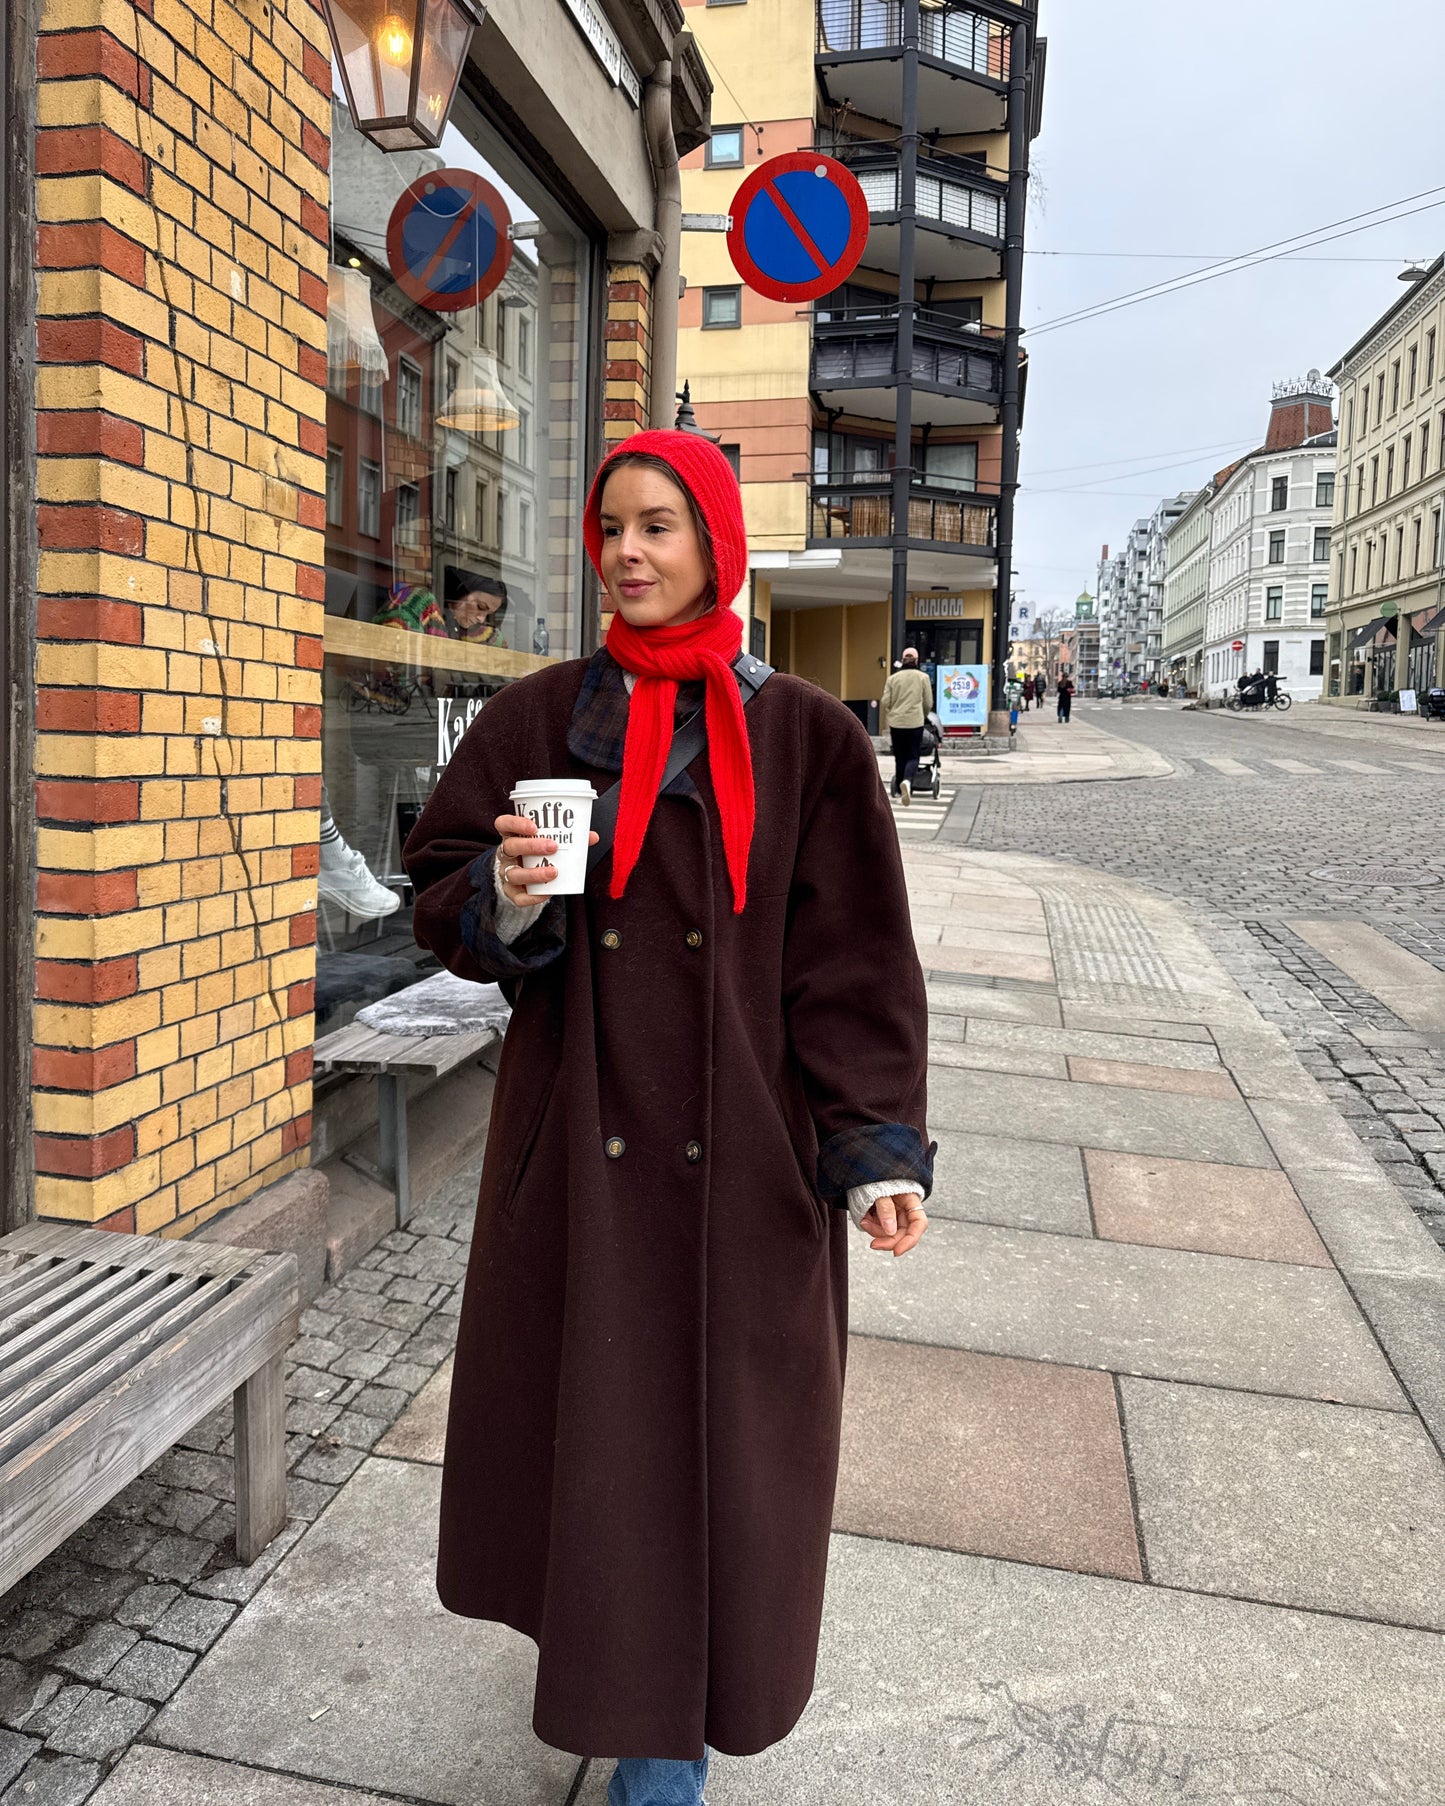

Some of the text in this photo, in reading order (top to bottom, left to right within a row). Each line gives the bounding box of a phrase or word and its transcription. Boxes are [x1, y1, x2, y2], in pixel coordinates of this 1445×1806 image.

[605, 36, 618, 72] gate
[1019, 607, 1028, 618] R
[1011, 627, 1019, 637] R
[436, 698, 483, 766] Kaf
